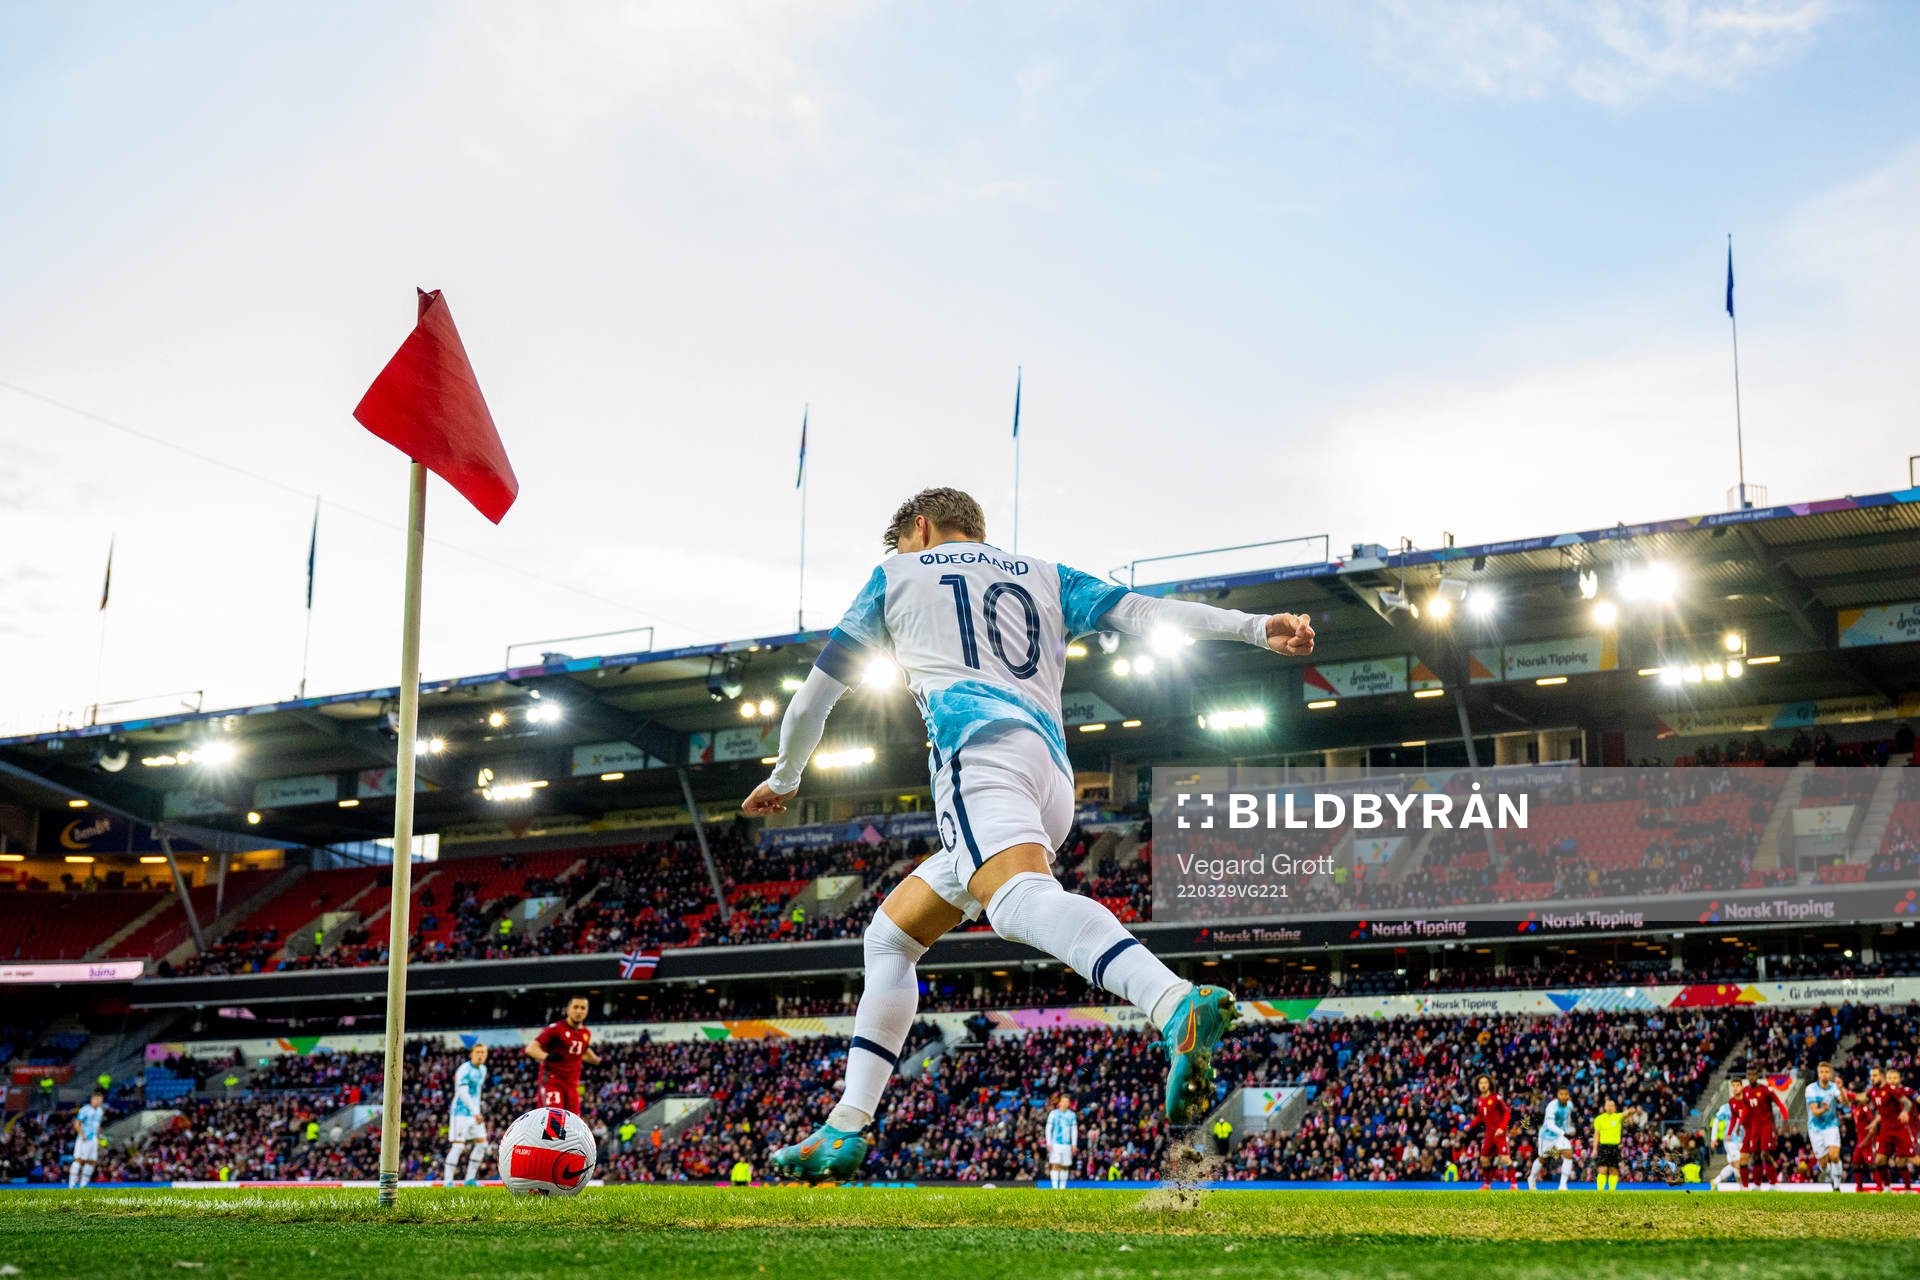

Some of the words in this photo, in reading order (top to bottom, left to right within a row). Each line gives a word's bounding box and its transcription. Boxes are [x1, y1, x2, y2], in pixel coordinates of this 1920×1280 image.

[919, 552, 1029, 576] ØDEGAARD
[938, 574, 1040, 680] 10
[1516, 655, 1548, 668] Norsk
[1550, 651, 1589, 667] Tipping
[1541, 912, 1585, 929] Norsk
[1586, 909, 1644, 928] Tipping
[1725, 902, 1771, 919] Norsk
[1772, 899, 1835, 919] Tipping
[1371, 922, 1412, 936] Norsk
[1413, 919, 1467, 937] Tipping
[1431, 999, 1460, 1011] Norsk
[1461, 998, 1499, 1012] Tipping
